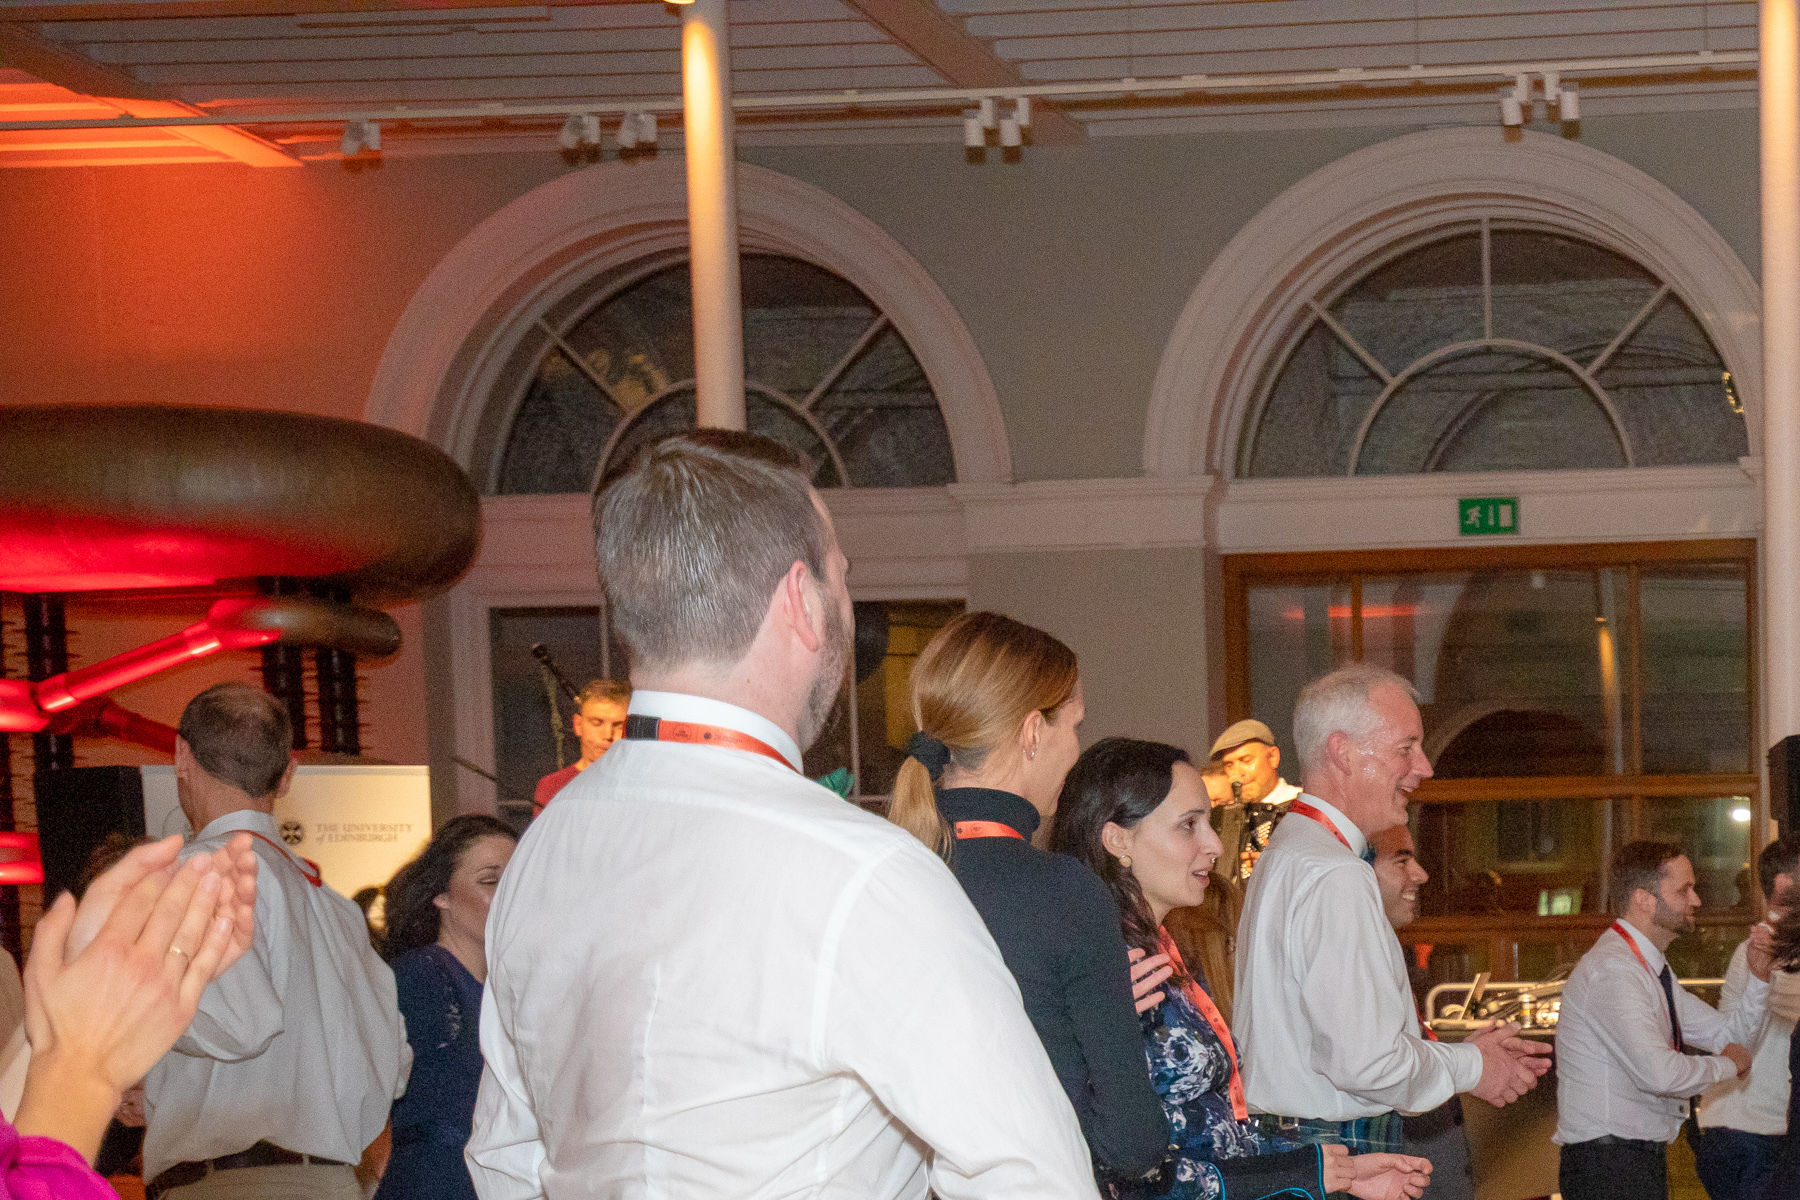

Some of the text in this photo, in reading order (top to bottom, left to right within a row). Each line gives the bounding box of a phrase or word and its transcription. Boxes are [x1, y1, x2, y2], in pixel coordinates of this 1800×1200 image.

[316, 822, 413, 833] THE UNIVERSITY
[327, 833, 398, 843] EDINBURGH
